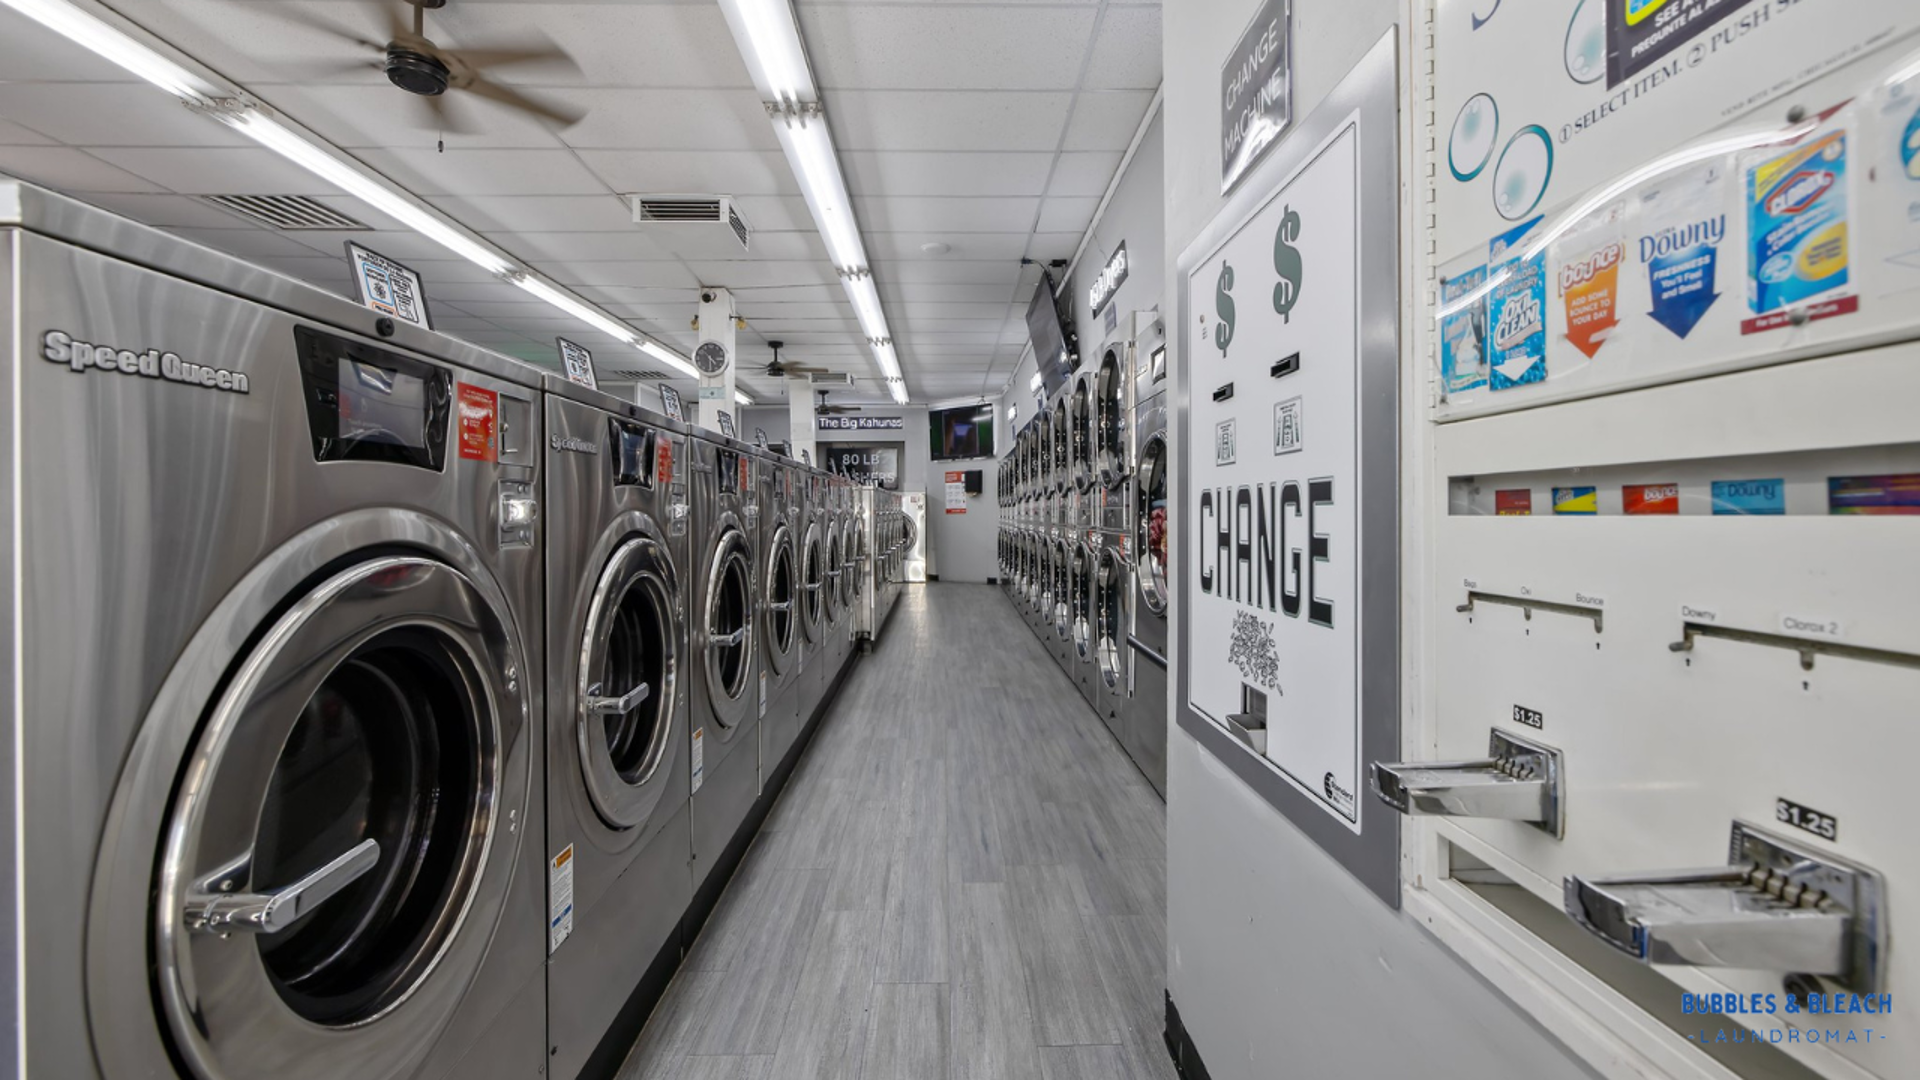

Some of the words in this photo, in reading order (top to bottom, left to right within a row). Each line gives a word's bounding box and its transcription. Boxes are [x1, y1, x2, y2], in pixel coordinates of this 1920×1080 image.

[1655, 1, 1679, 27] SEE
[1631, 13, 1687, 58] PREGUNTE
[1226, 18, 1279, 110] CHANGE
[1574, 88, 1630, 134] SELECT
[1634, 60, 1683, 99] ITEM.
[1711, 3, 1770, 53] PUSH
[1224, 67, 1281, 161] MACHINE
[1639, 214, 1725, 263] Downy
[1562, 243, 1620, 290] bounce
[1653, 254, 1711, 281] FRESHNESS
[1505, 292, 1528, 320] OXI
[1570, 302, 1599, 318] BOUNCE
[1600, 298, 1611, 309] TO
[1573, 314, 1591, 325] YOUR
[1593, 309, 1608, 320] DAY
[1496, 301, 1538, 346] CLEAN
[44, 329, 161, 378] Speed
[161, 351, 250, 395] Queen
[819, 417, 839, 428] The
[841, 417, 858, 430] Big
[859, 417, 903, 428] Kahunas
[842, 454, 860, 465] 80
[863, 454, 880, 465] LB
[1200, 476, 1335, 630] CHANGE
[1576, 592, 1604, 606] Bounce
[1682, 605, 1717, 621] Downy
[1783, 617, 1825, 633] Clorox
[1829, 621, 1839, 635] 2
[1514, 707, 1541, 727] $1.25
[1777, 801, 1835, 838] $1.25
